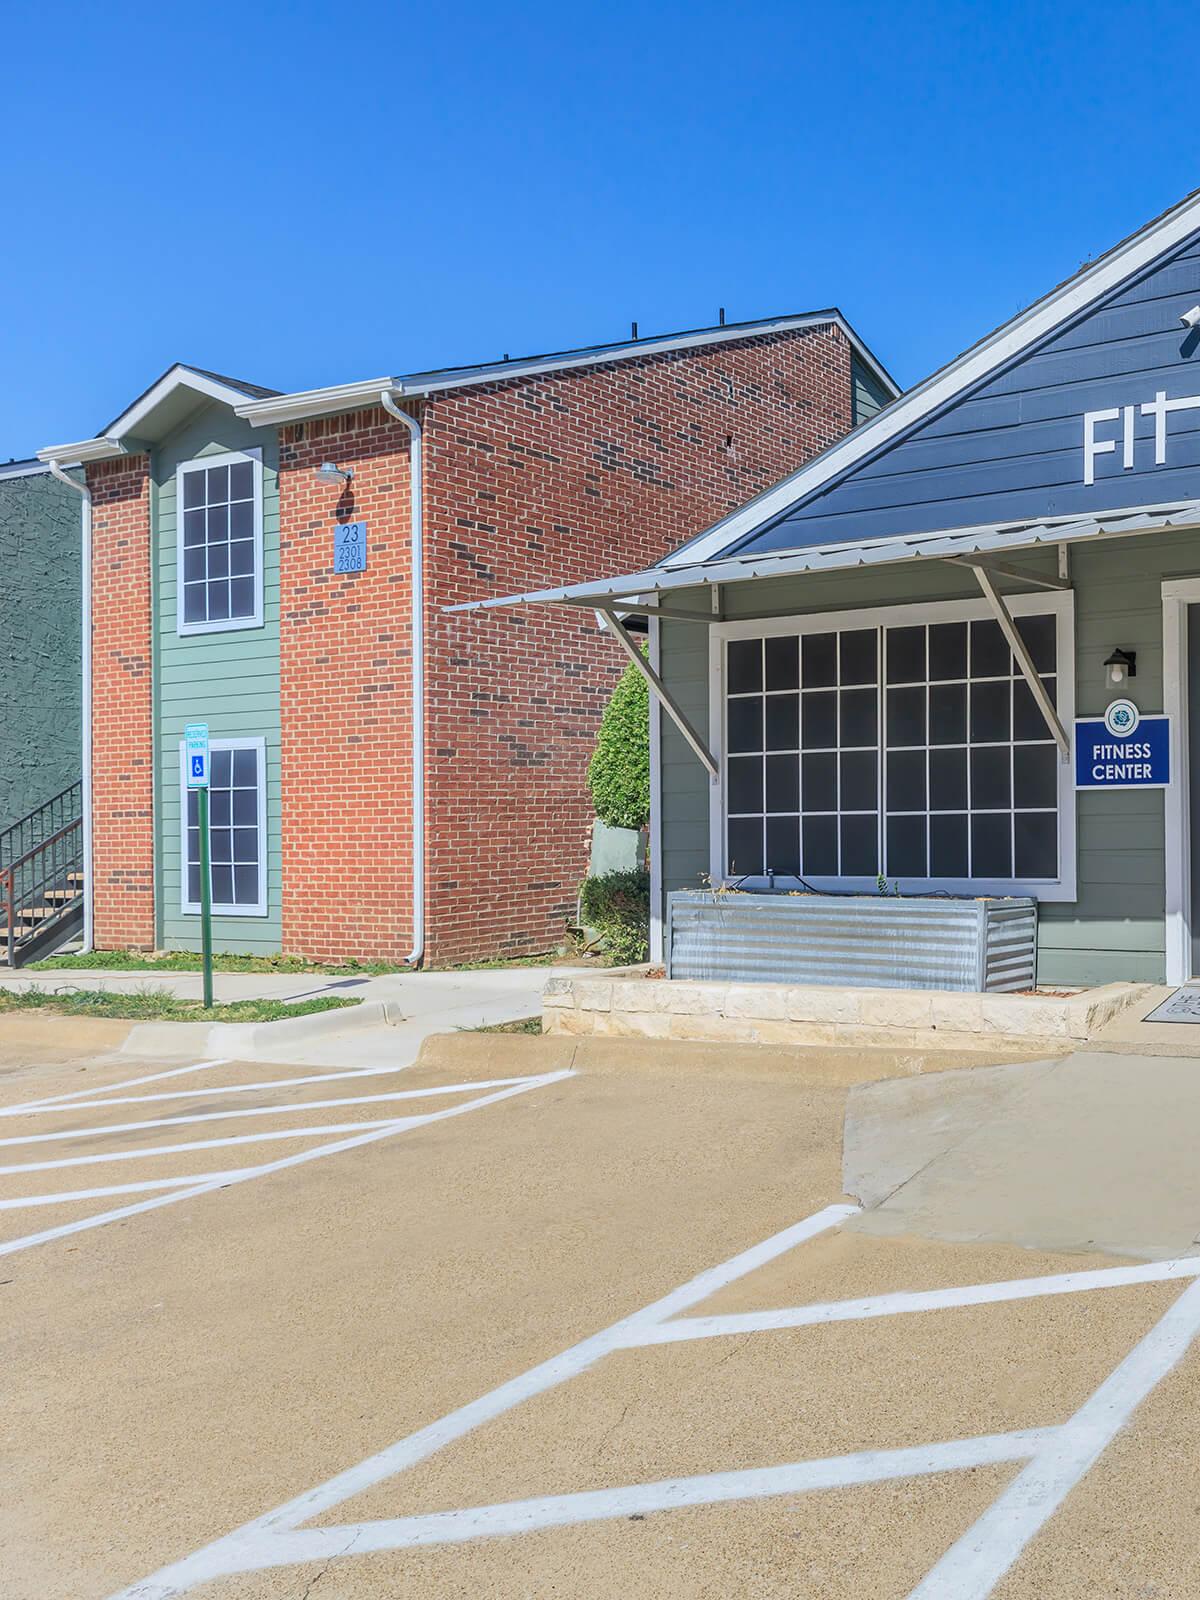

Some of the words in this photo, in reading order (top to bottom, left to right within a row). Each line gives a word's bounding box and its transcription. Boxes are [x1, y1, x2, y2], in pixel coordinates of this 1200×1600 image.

[342, 524, 359, 544] 23
[339, 545, 361, 559] 2301
[338, 557, 362, 571] 2308
[1092, 742, 1152, 760] FITNESS
[1092, 763, 1152, 780] CENTER
